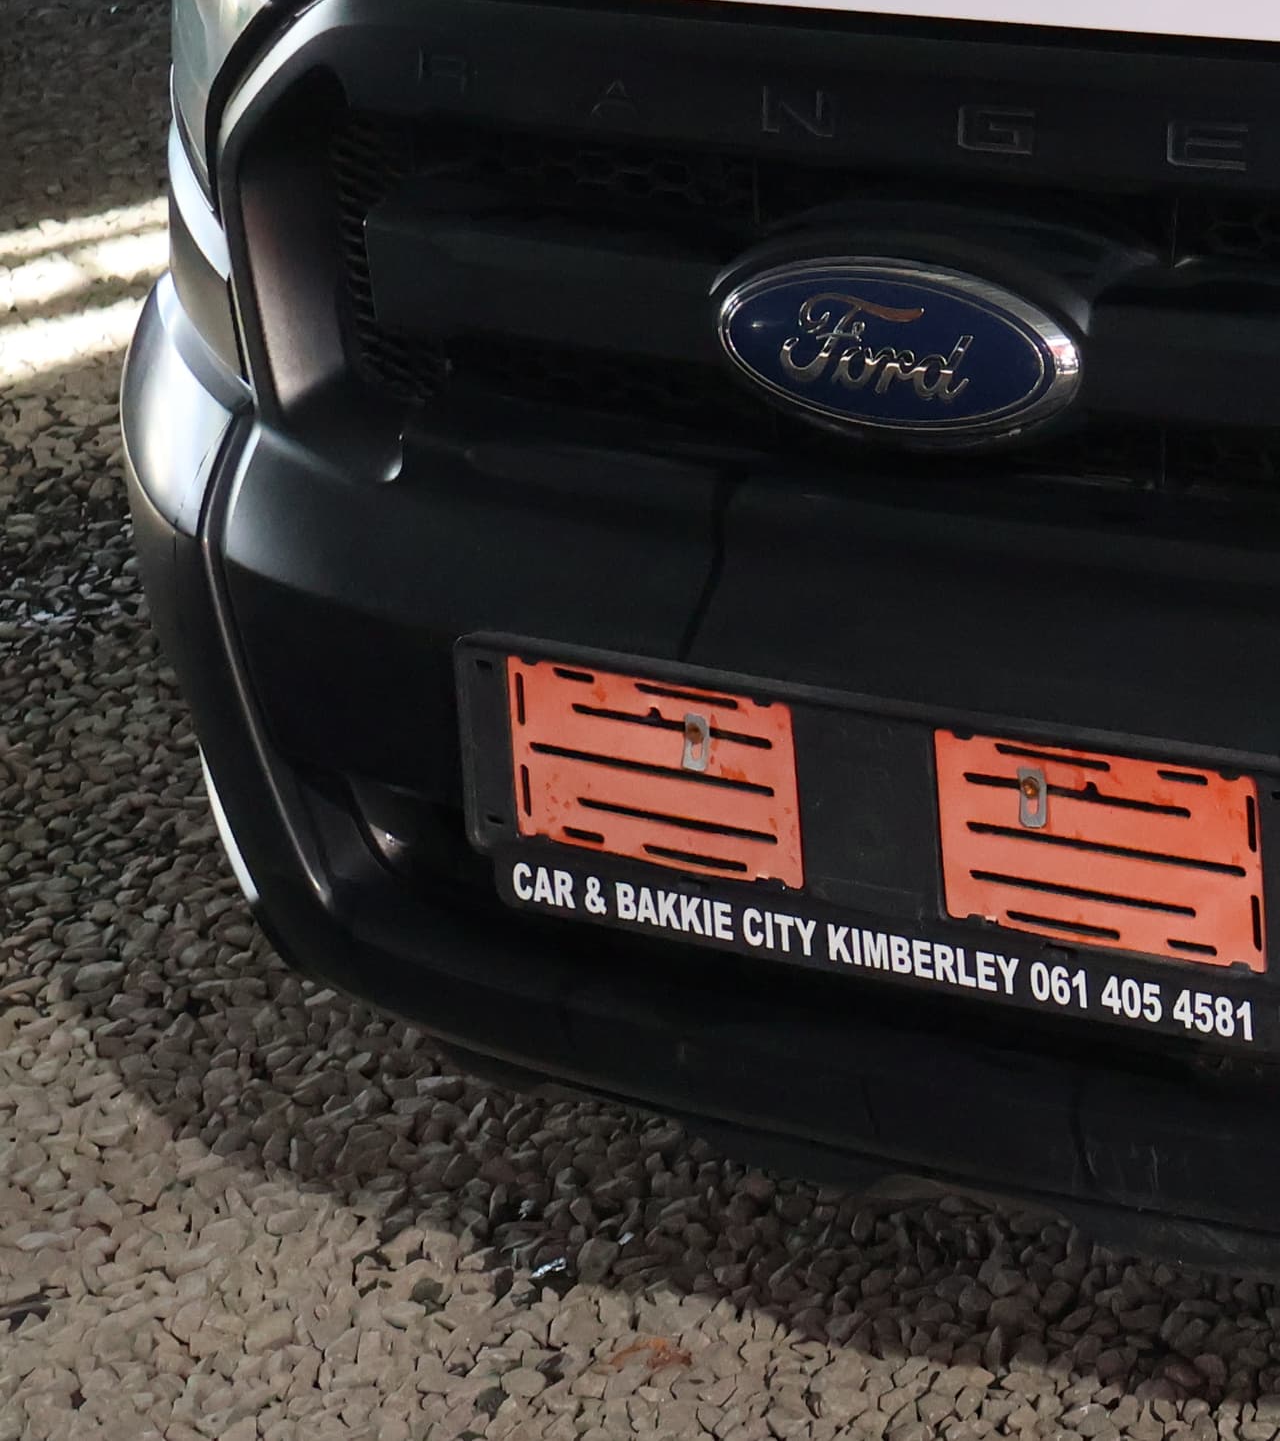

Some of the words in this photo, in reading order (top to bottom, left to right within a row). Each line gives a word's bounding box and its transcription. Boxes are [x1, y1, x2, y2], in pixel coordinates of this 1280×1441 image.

[779, 292, 974, 402] Ford
[512, 861, 576, 909] CAR
[584, 876, 607, 915] &
[615, 881, 734, 941] BAKKIE
[742, 907, 817, 957] CITY
[826, 923, 1020, 995] KIMBERLEY
[1030, 961, 1088, 1009] 061
[1101, 975, 1163, 1023] 405
[1173, 989, 1253, 1041] 4581
